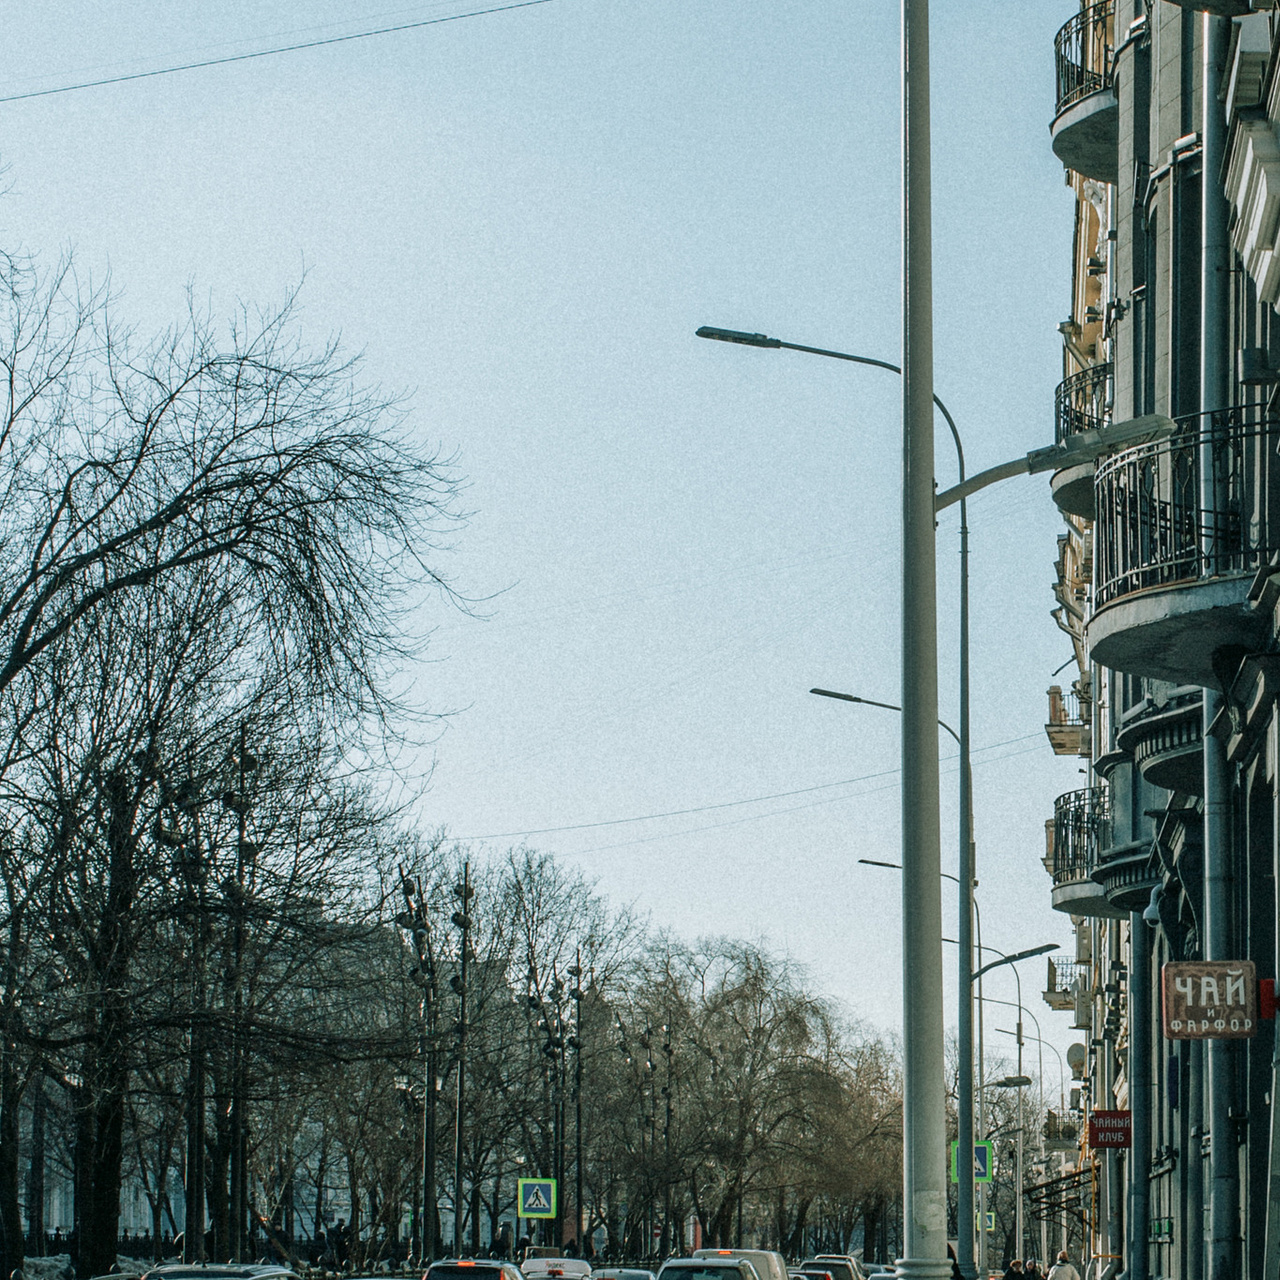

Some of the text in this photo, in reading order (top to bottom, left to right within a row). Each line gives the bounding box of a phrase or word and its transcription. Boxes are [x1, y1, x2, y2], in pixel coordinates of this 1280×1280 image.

[1175, 968, 1246, 1006] ЧАЙ
[1170, 1018, 1252, 1033] ФАРФОР
[1092, 1115, 1131, 1128] ЧАЙНЫЙ
[1098, 1132, 1125, 1142] КЛУБ
